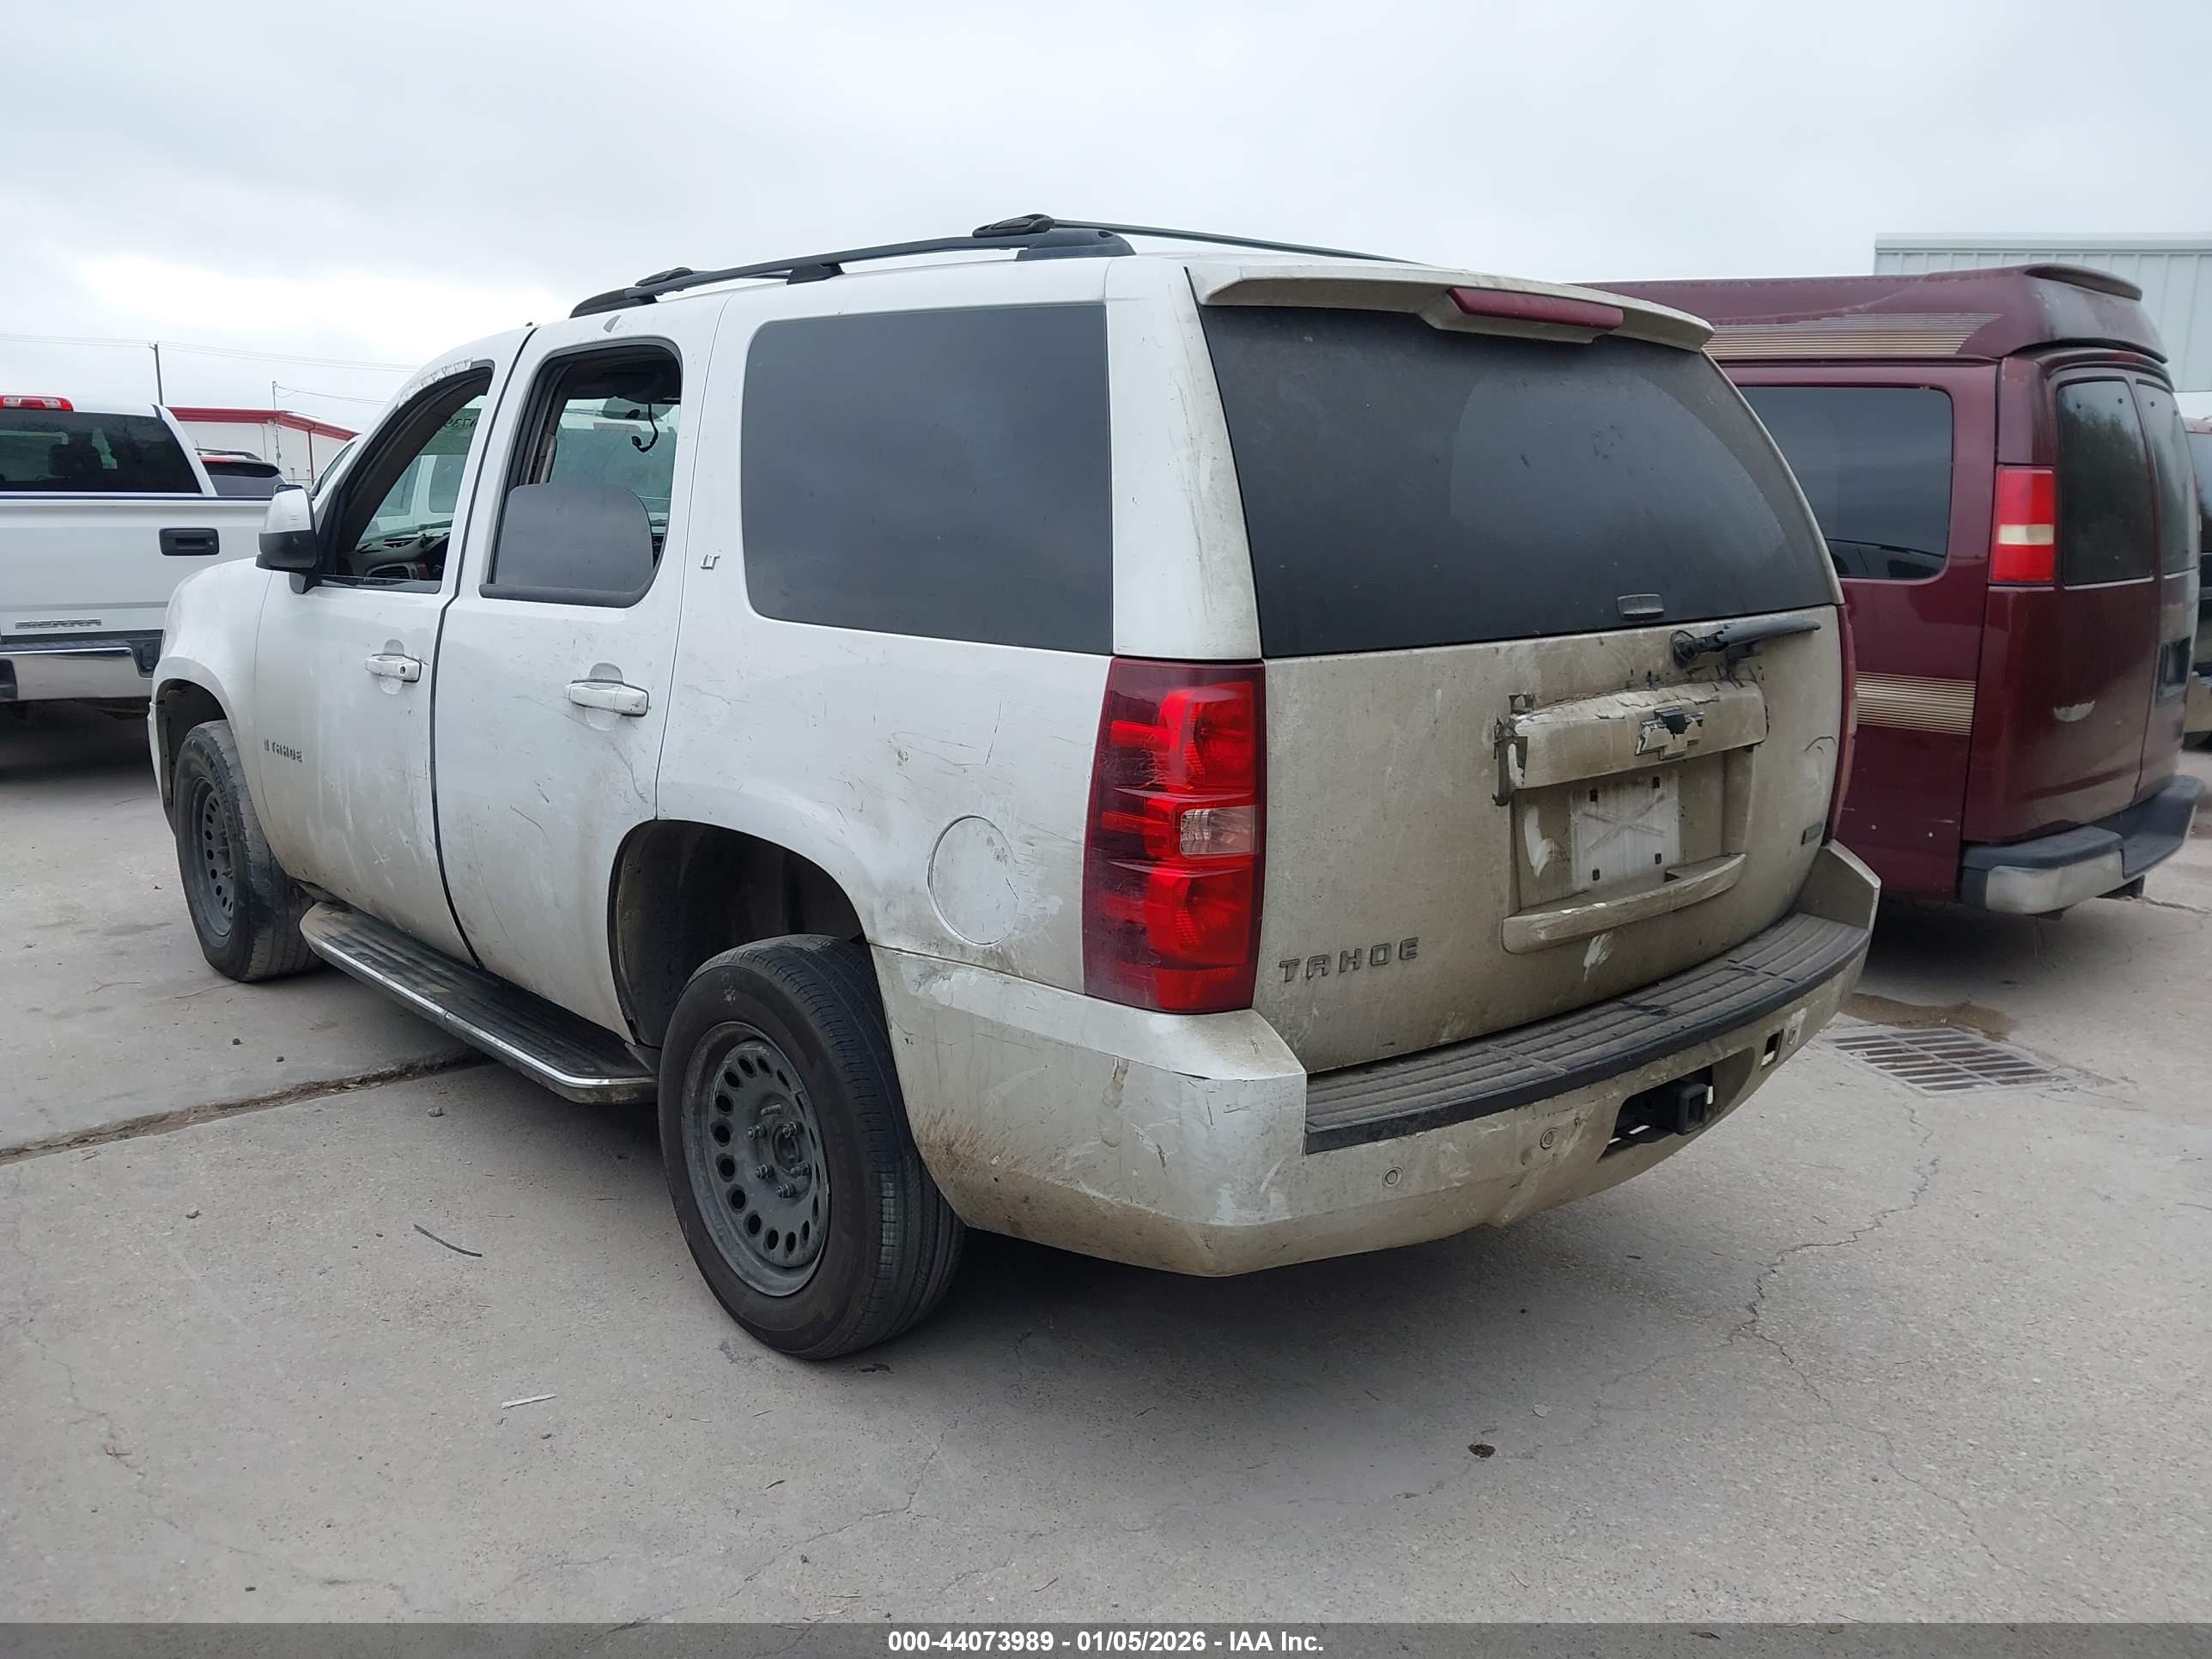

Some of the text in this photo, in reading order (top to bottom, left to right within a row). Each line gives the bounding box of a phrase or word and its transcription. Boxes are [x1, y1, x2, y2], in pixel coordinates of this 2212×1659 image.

[700, 554, 720, 570] LT
[15, 619, 102, 629] SIERRA
[271, 741, 303, 763] TAHOE
[1279, 937, 1419, 983] TAHOE
